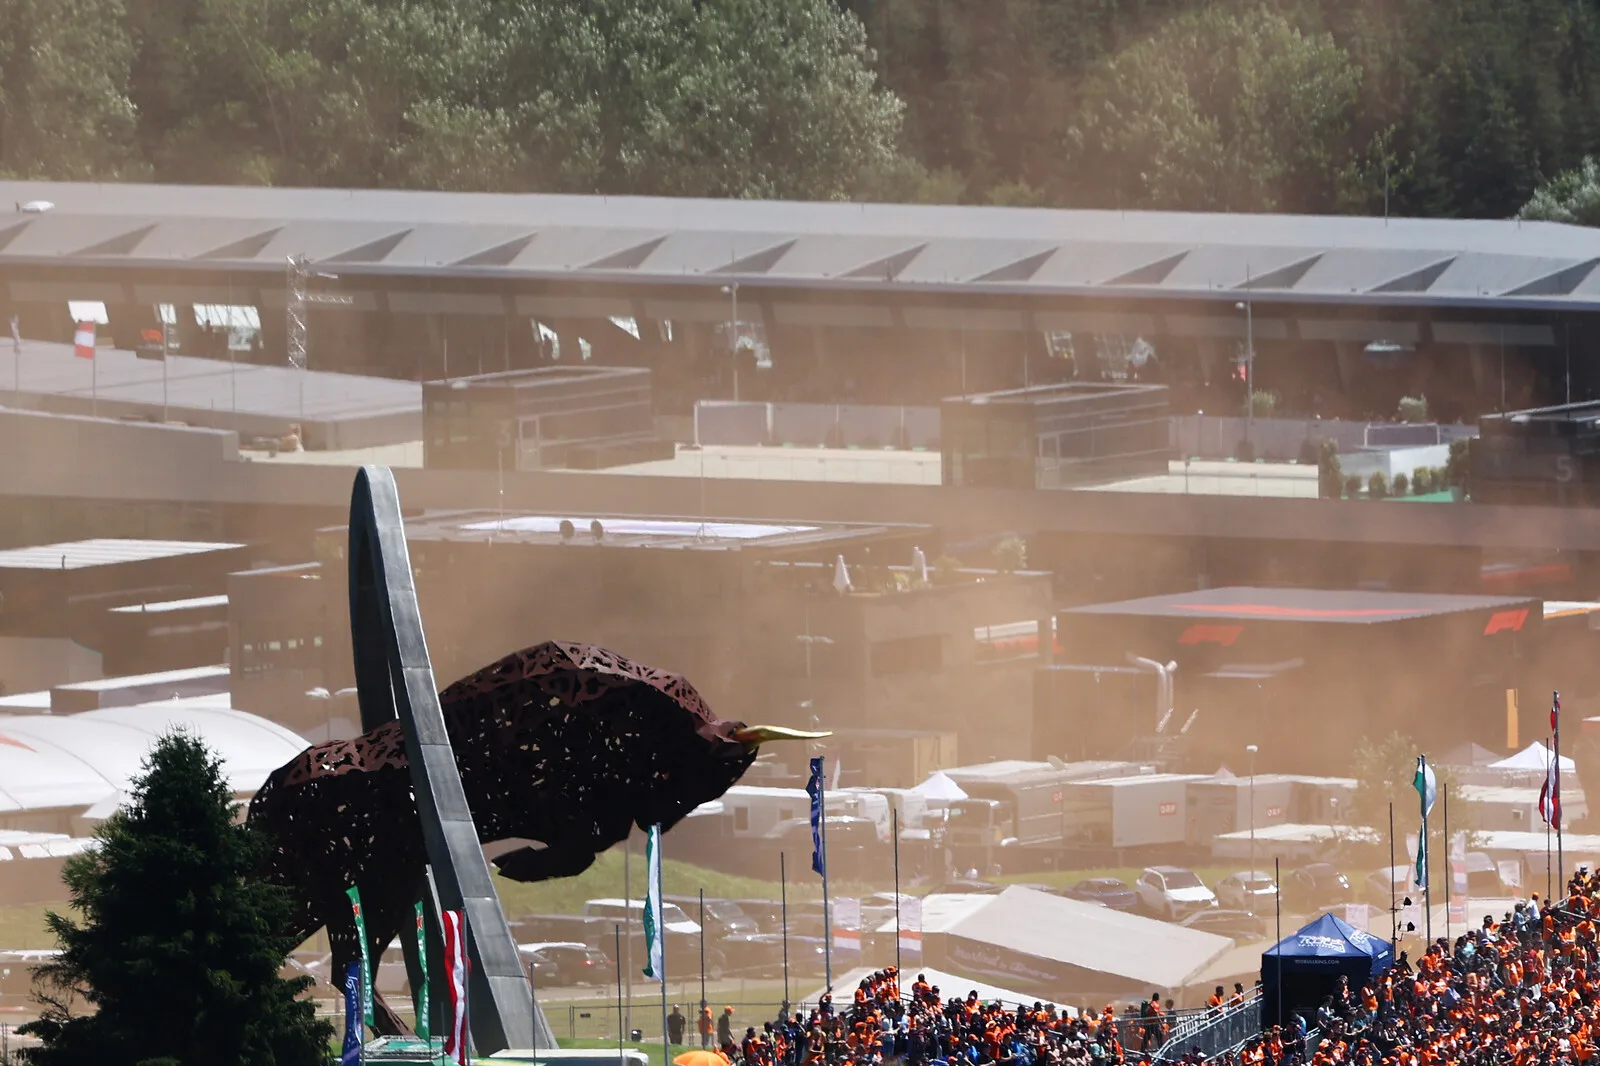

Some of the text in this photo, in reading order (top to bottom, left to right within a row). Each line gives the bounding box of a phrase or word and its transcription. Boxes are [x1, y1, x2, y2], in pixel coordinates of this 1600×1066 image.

[1556, 455, 1573, 482] 5
[1160, 804, 1176, 814] ORF
[1267, 808, 1282, 817] ORF
